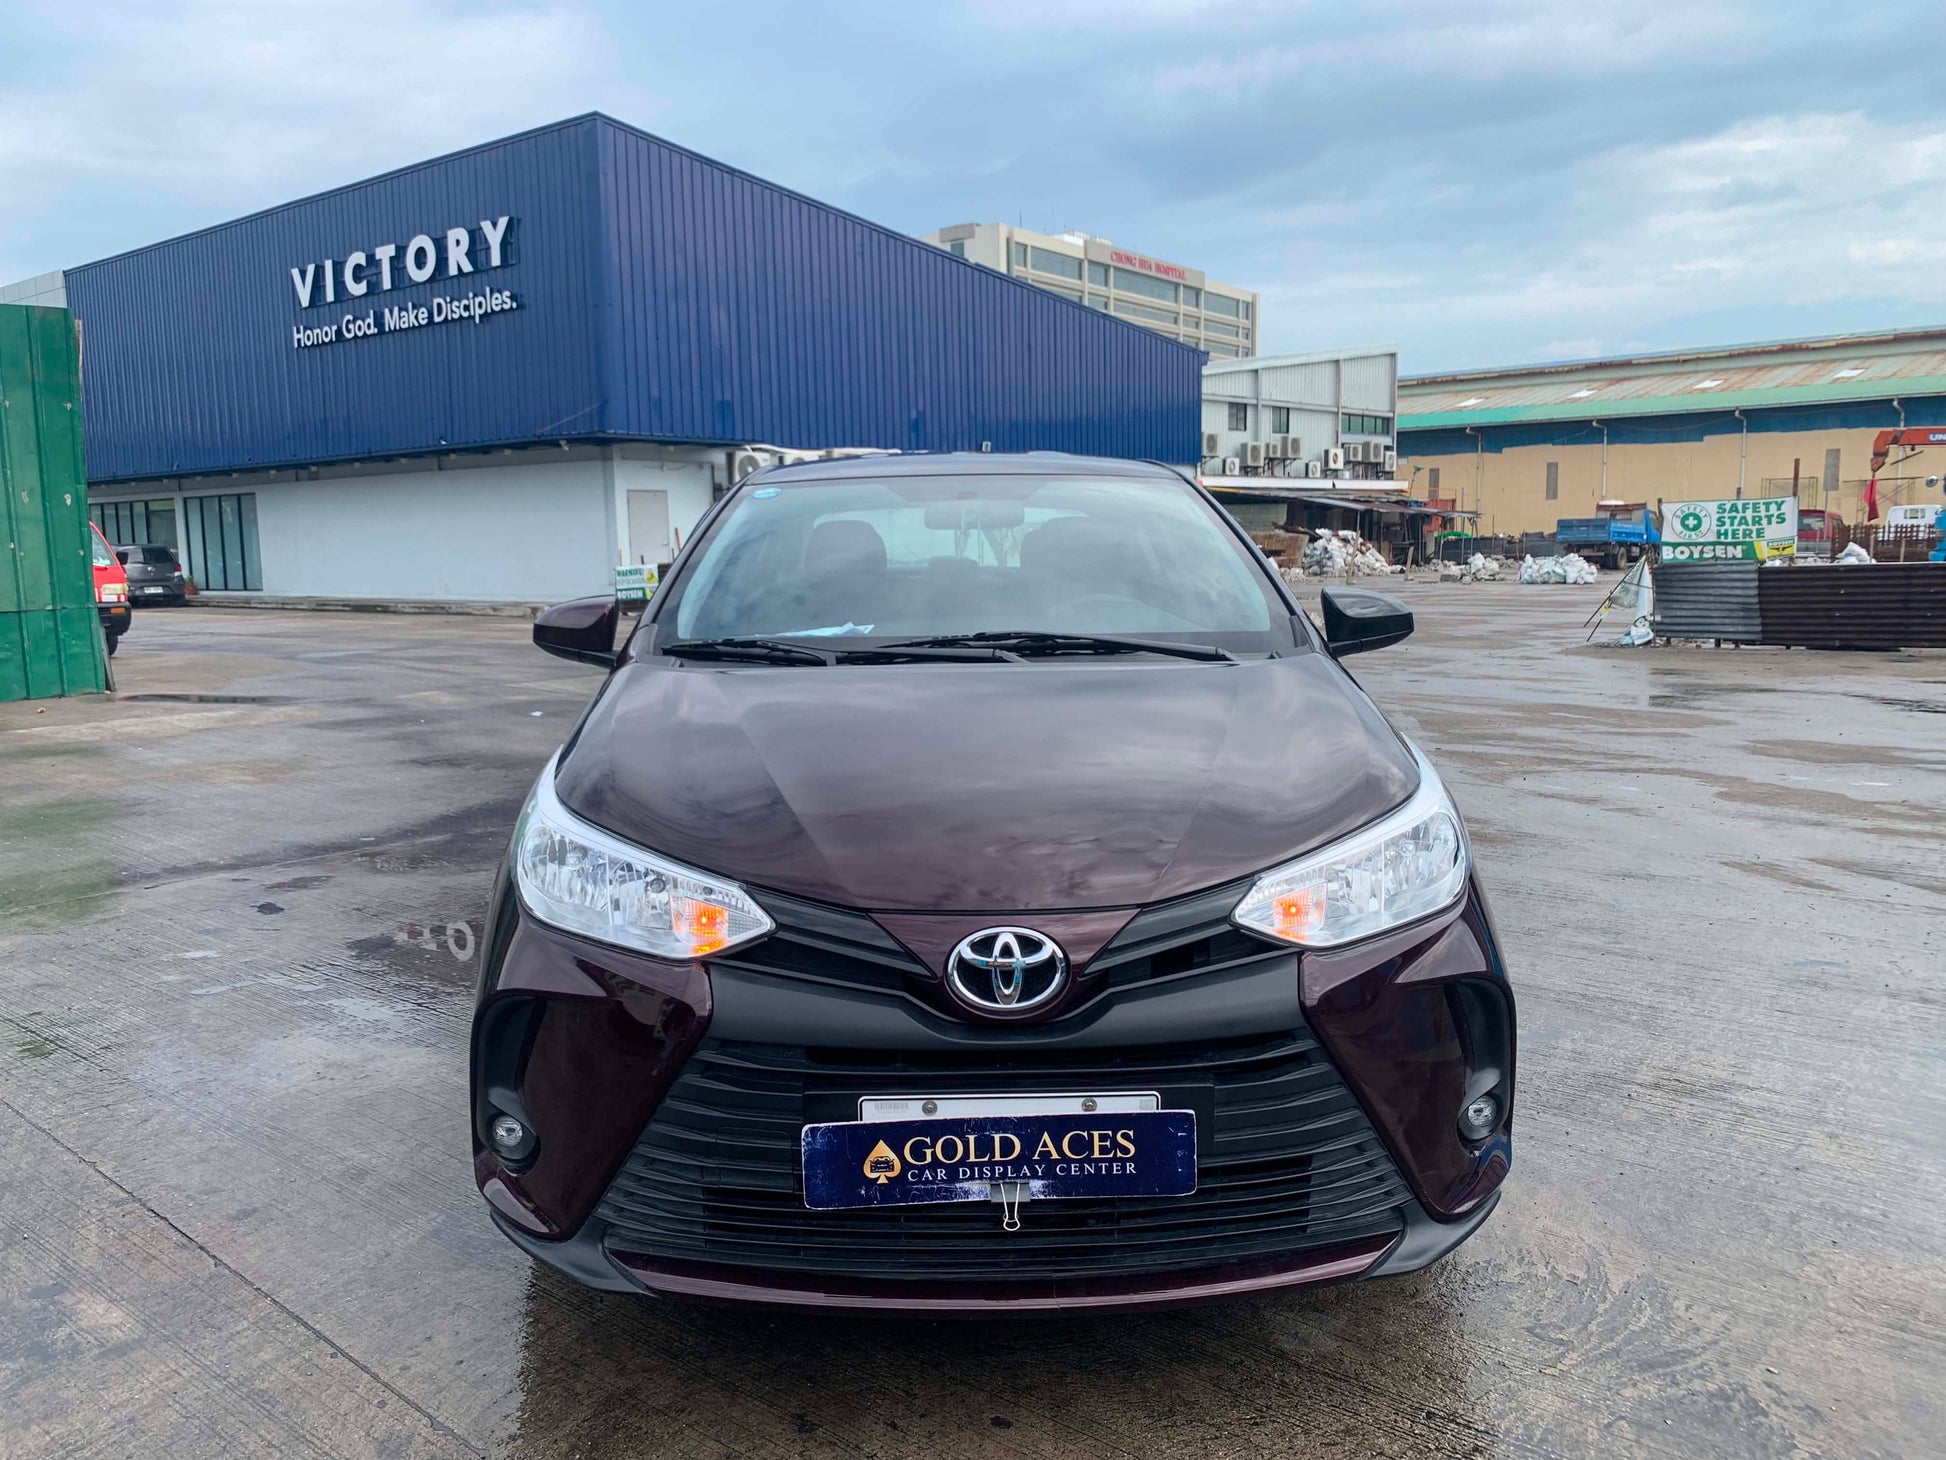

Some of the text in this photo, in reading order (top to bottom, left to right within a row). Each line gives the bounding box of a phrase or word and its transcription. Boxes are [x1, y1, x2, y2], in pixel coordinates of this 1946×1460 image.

[291, 216, 509, 309] VICTORY
[293, 286, 517, 348] Honor God. Make Disciples.
[1675, 506, 1708, 519] SAFETY
[1716, 500, 1785, 514] SAFETY
[1716, 513, 1786, 528] STARTS
[1716, 527, 1765, 540] HERE
[1662, 545, 1743, 560] BOYSEN
[903, 1129, 1136, 1165] GOLD ACES
[907, 1162, 1137, 1182] CAR DISPLAY CENTER
